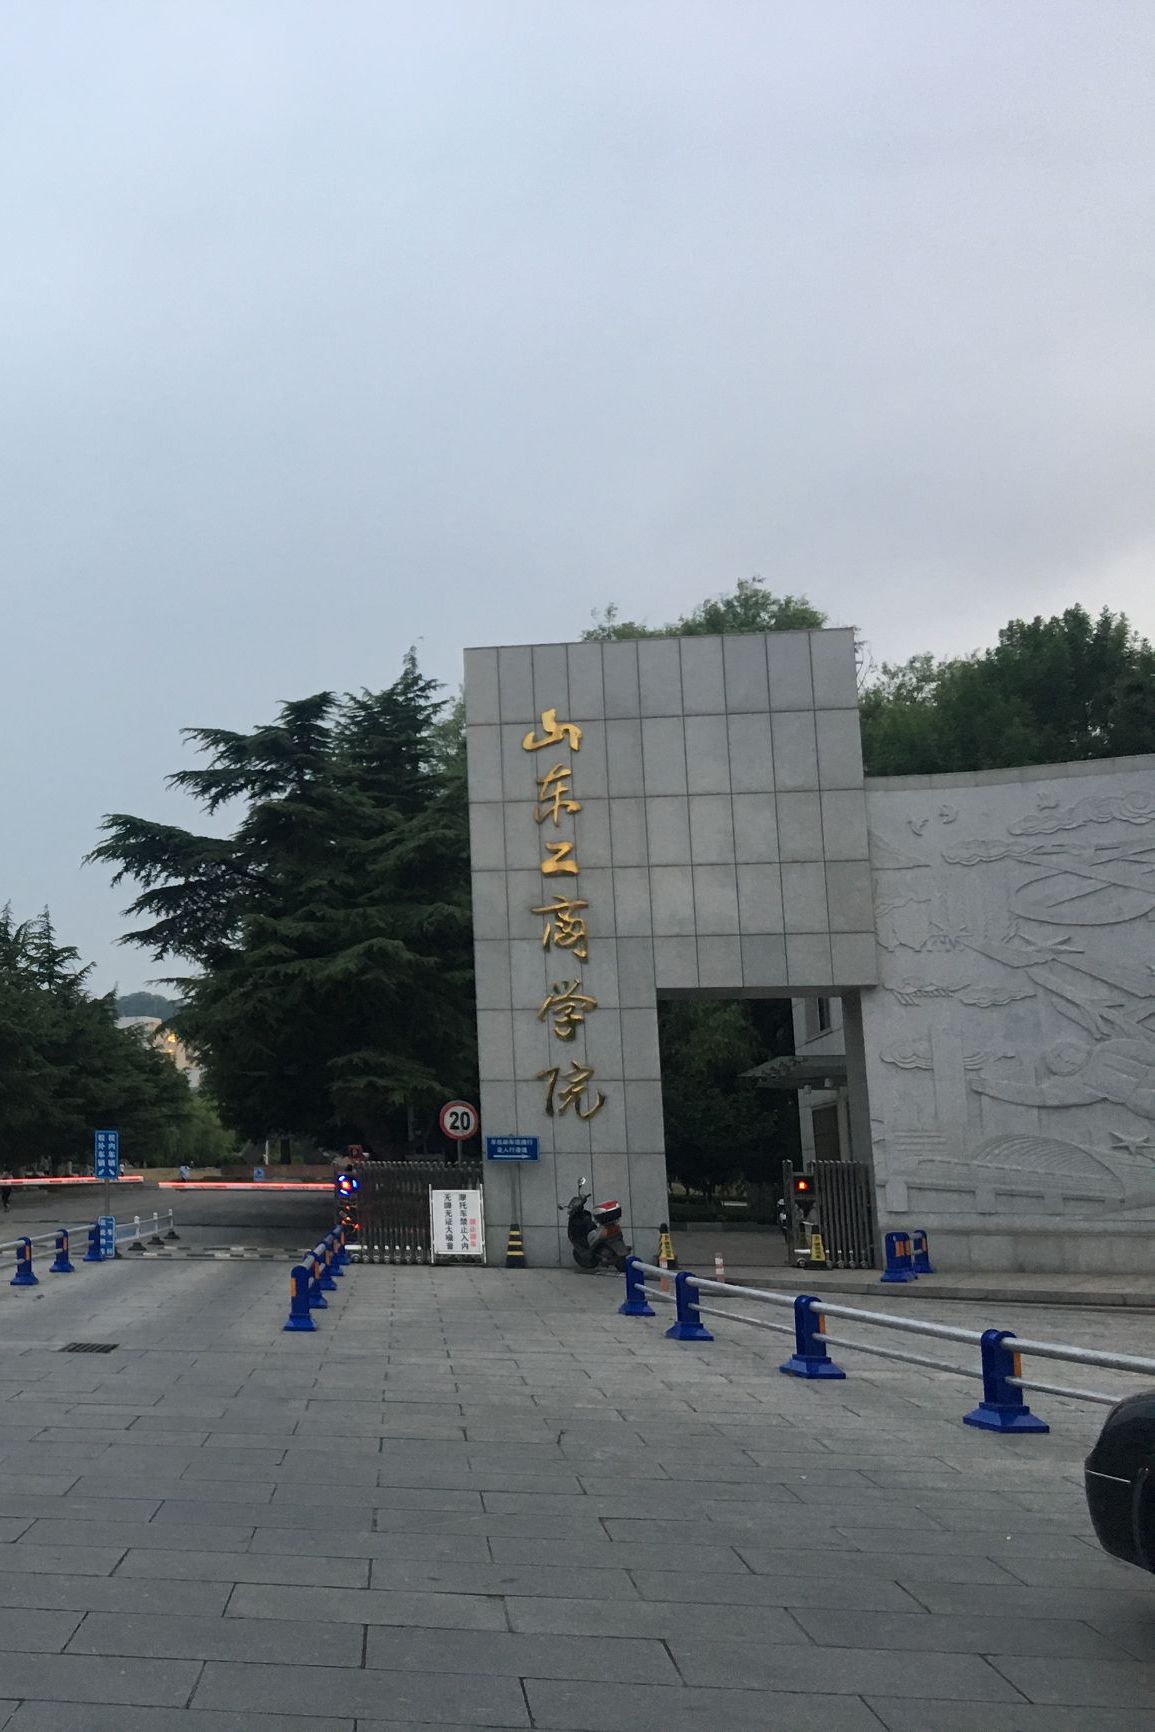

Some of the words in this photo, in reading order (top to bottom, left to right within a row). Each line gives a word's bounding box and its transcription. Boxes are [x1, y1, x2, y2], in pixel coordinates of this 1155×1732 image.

[521, 707, 606, 1120] 山东工商学院
[449, 1111, 470, 1130] 20
[458, 1193, 469, 1250] 摩托车禁止入内
